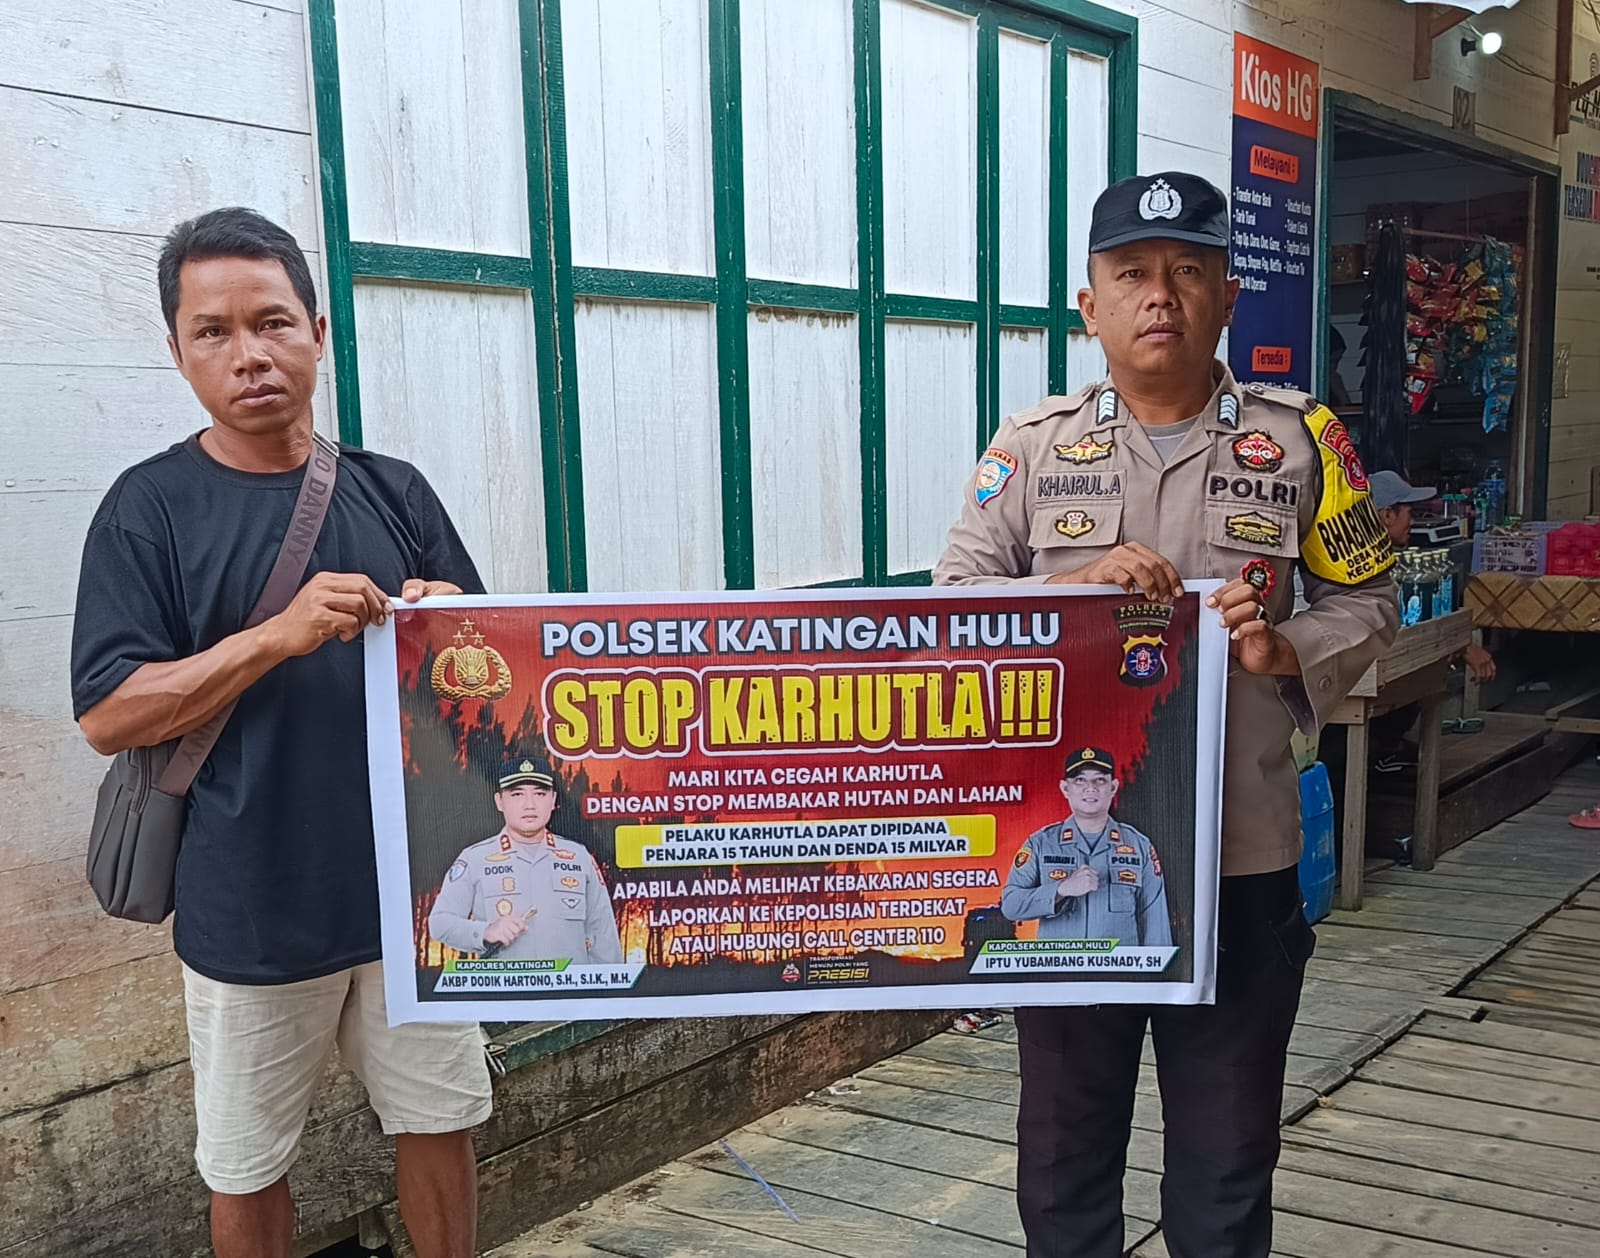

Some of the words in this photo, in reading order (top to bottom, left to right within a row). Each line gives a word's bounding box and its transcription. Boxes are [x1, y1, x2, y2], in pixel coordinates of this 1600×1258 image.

[1241, 50, 1281, 112] Kios
[1287, 67, 1312, 121] HG
[1254, 149, 1291, 175] Melayani
[1257, 349, 1283, 365] Tersedia
[1037, 474, 1121, 498] KHAIRUL.A
[1209, 475, 1297, 506] POLRI
[288, 476, 328, 566] DANNY
[1347, 553, 1372, 569] DESA
[1347, 566, 1373, 581] KEC.
[1120, 604, 1165, 613] POLRES
[543, 619, 708, 656] POLSEK
[718, 615, 936, 652] KATINGAN
[950, 612, 1060, 647] HULU
[553, 678, 695, 749] STOP
[709, 671, 986, 745] KARHUTLA
[1000, 670, 1053, 737] !!!
[668, 770, 719, 787] MARI
[724, 768, 767, 785] KITA
[771, 766, 837, 785] CEGAH
[843, 764, 943, 783] KARHUTLA
[587, 796, 668, 814] DENGAN
[673, 794, 723, 812] STOP
[728, 791, 839, 810] MEMBAKAR
[845, 789, 908, 807] HUTAN
[914, 787, 953, 804] DAN
[959, 785, 1022, 803] LAHAN
[666, 828, 725, 842] PELAKU
[730, 826, 813, 841] KARHUTLA
[817, 824, 867, 838] DAPAT
[871, 821, 947, 836] DIPIDANA
[646, 847, 718, 861] PENJARA
[722, 847, 736, 859] 15
[739, 845, 794, 859] TAHUN
[798, 844, 831, 857] DAN
[835, 842, 888, 856] DENDA
[891, 841, 905, 854] 15
[909, 839, 966, 853] MILYAR
[484, 865, 514, 876] DODIK
[553, 862, 582, 872] POLRI
[613, 880, 687, 900] APABILA
[691, 879, 743, 896] ANDA
[746, 876, 820, 894] MELIHAT
[824, 871, 929, 891] KEBAKARAN
[932, 869, 999, 888] SEGERA
[650, 907, 744, 927] LAPORKAN
[750, 905, 770, 922] KE
[775, 900, 875, 921] KEPOLISIAN
[879, 899, 965, 917] TERDEKAT
[671, 936, 715, 954] ATAU
[720, 933, 799, 951] HUBUNGI
[804, 930, 847, 948] CALL
[850, 928, 917, 946] CENTER
[921, 927, 944, 943] 110
[989, 942, 1034, 951] KAPOLSEK
[1037, 941, 1083, 950] KATINGAN
[1086, 941, 1110, 950] HULU
[456, 961, 504, 970] KAPOLRES
[507, 960, 554, 969] KATINGAN
[985, 957, 1011, 968] IPTU
[1014, 956, 1084, 968] YUBAMBANG
[1087, 955, 1143, 969] KUSNADY,
[1146, 955, 1161, 967] SH
[441, 976, 468, 988] AKBP
[471, 975, 501, 988] DODIK
[504, 974, 554, 988] HARTONO,
[610, 972, 631, 984] M.H.
[807, 968, 869, 980] PRESISI
